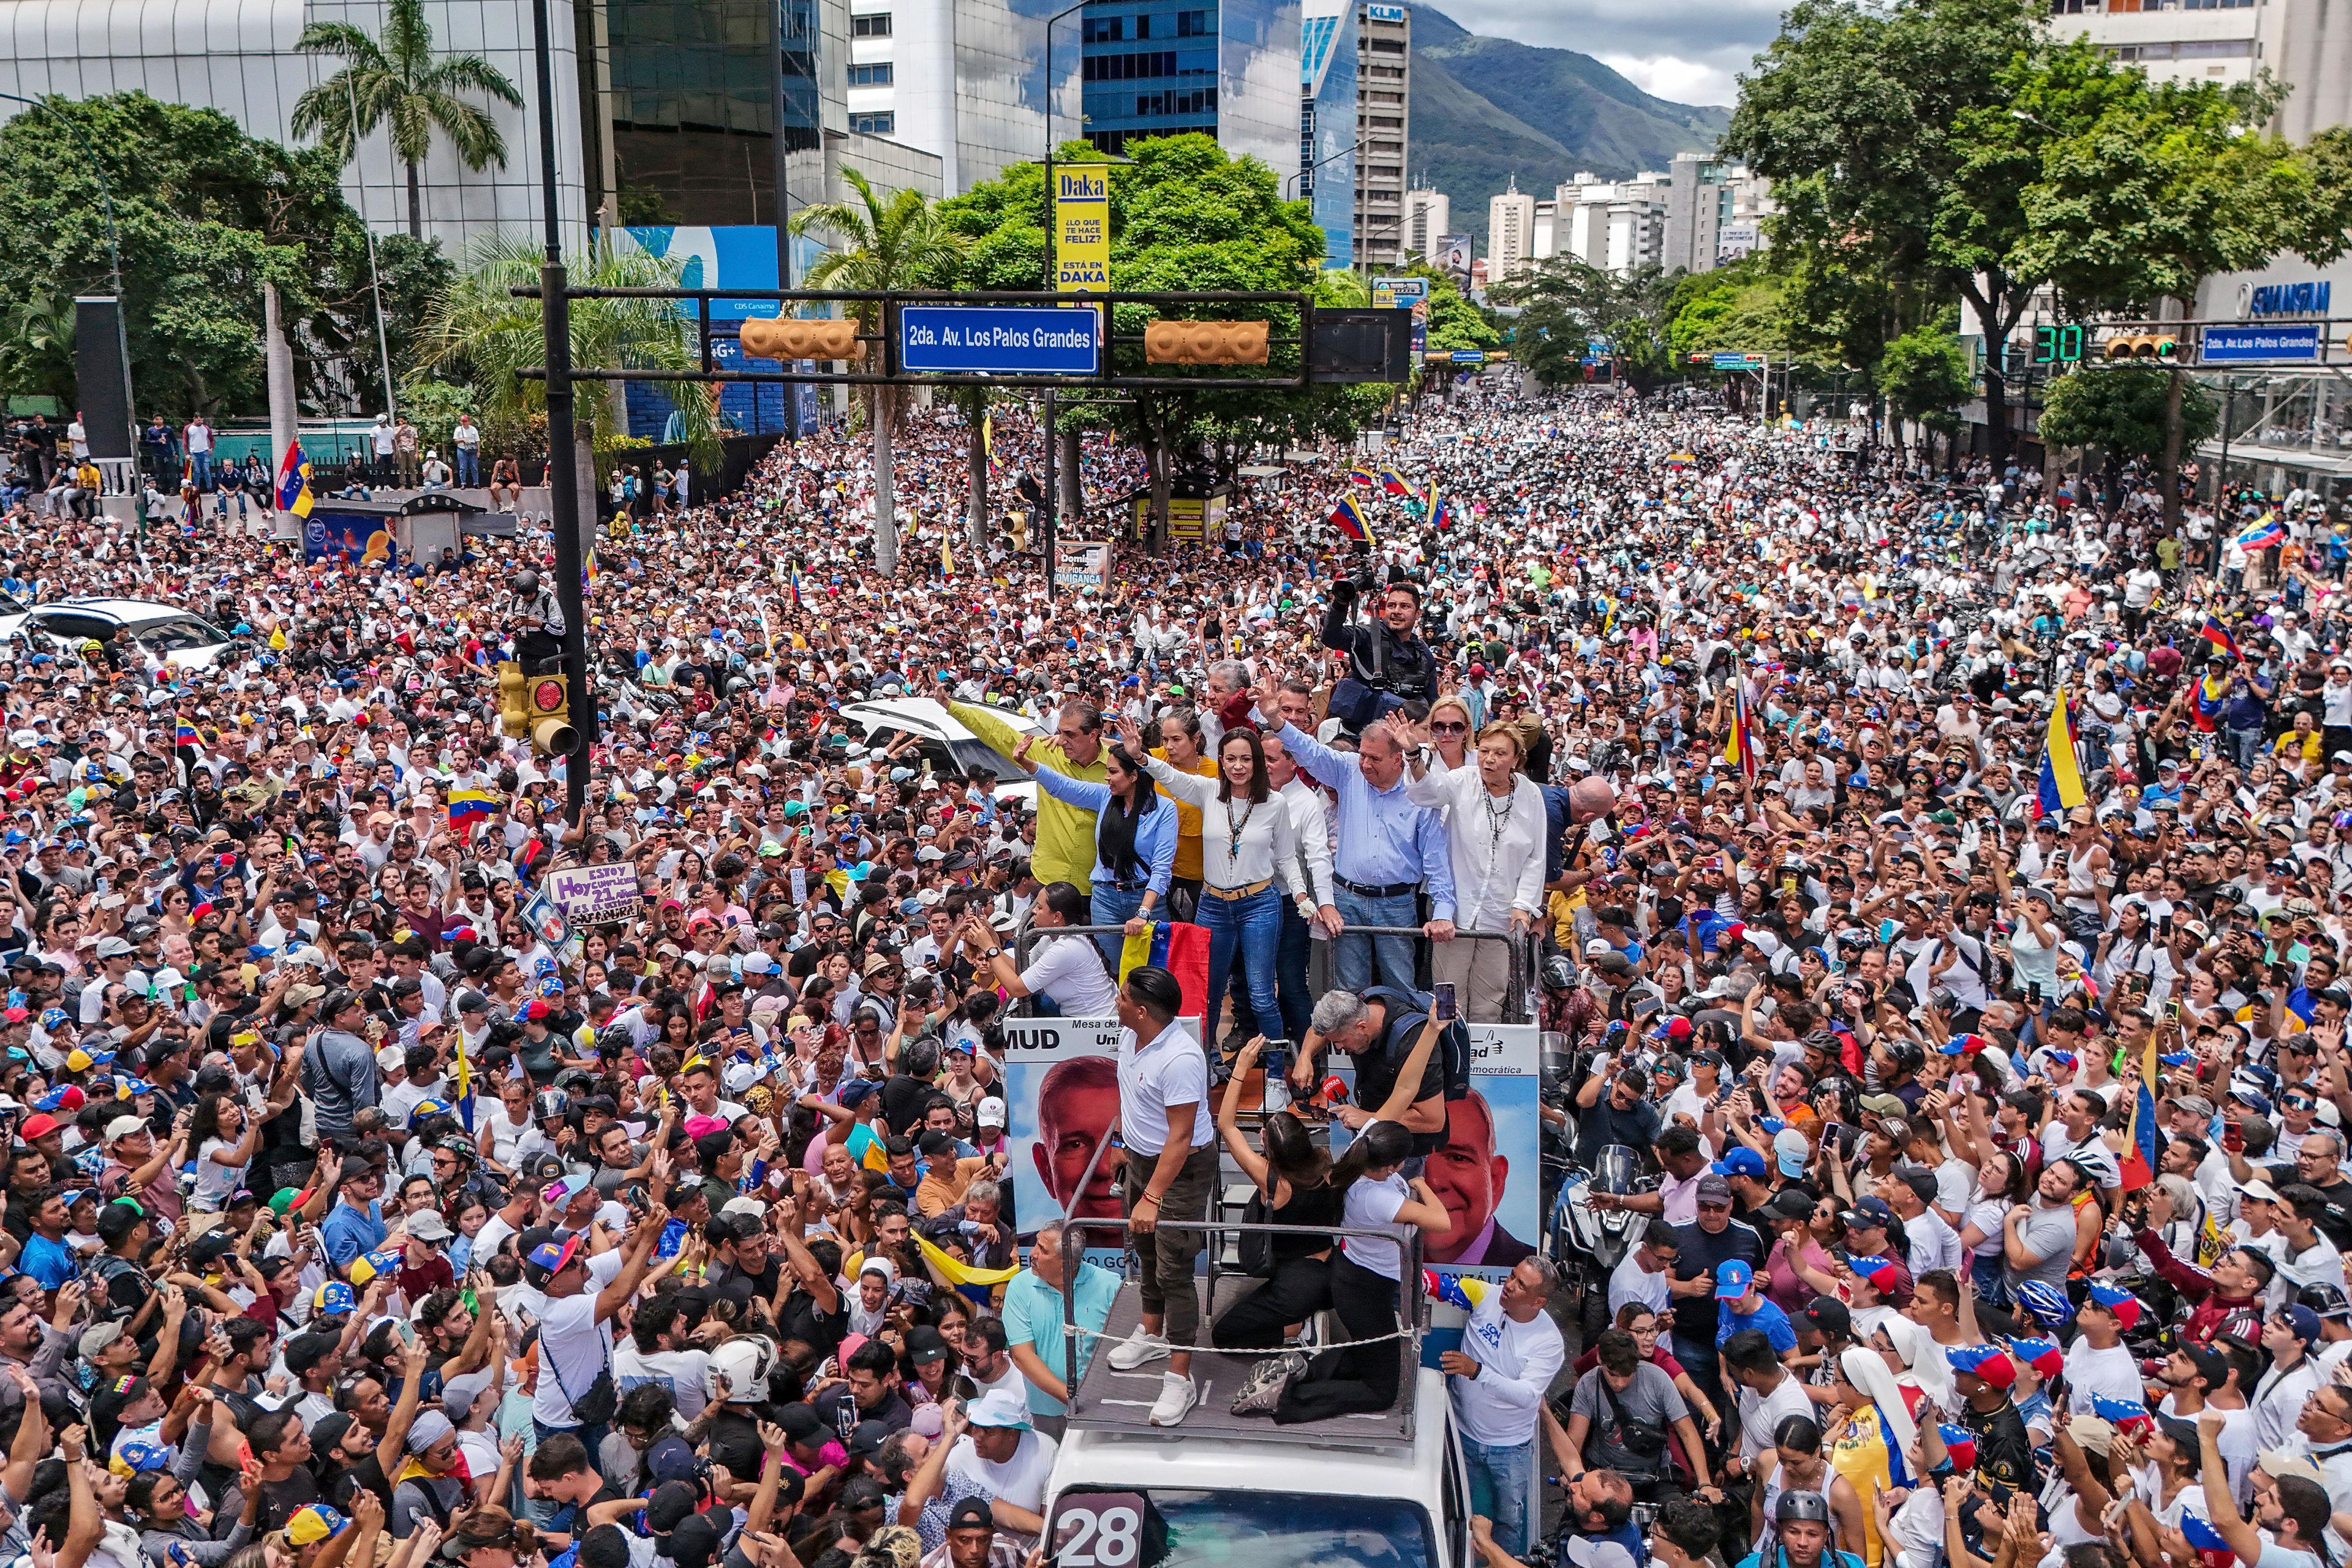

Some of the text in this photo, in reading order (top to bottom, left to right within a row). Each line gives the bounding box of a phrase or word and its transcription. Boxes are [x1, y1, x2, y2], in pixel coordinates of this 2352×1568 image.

[1370, 6, 1402, 20] KLM
[1060, 175, 1104, 197] Daka
[1061, 271, 1106, 282] DAKA
[1376, 293, 1392, 302] Daka
[909, 325, 1090, 349] 2da. Av. Los Palos Grandes
[2207, 339, 2223, 350] 2da.
[2237, 338, 2253, 348] Los
[2255, 337, 2277, 348] Palos
[2280, 336, 2313, 348] Grandes
[2037, 326, 2081, 363] 30
[589, 867, 625, 880] ESTOY
[592, 888, 615, 903] 21
[574, 905, 589, 914] ES
[1072, 1020, 1100, 1028] Mesa
[1486, 1323, 1501, 1340] CON
[1057, 1507, 1139, 1566] 28
